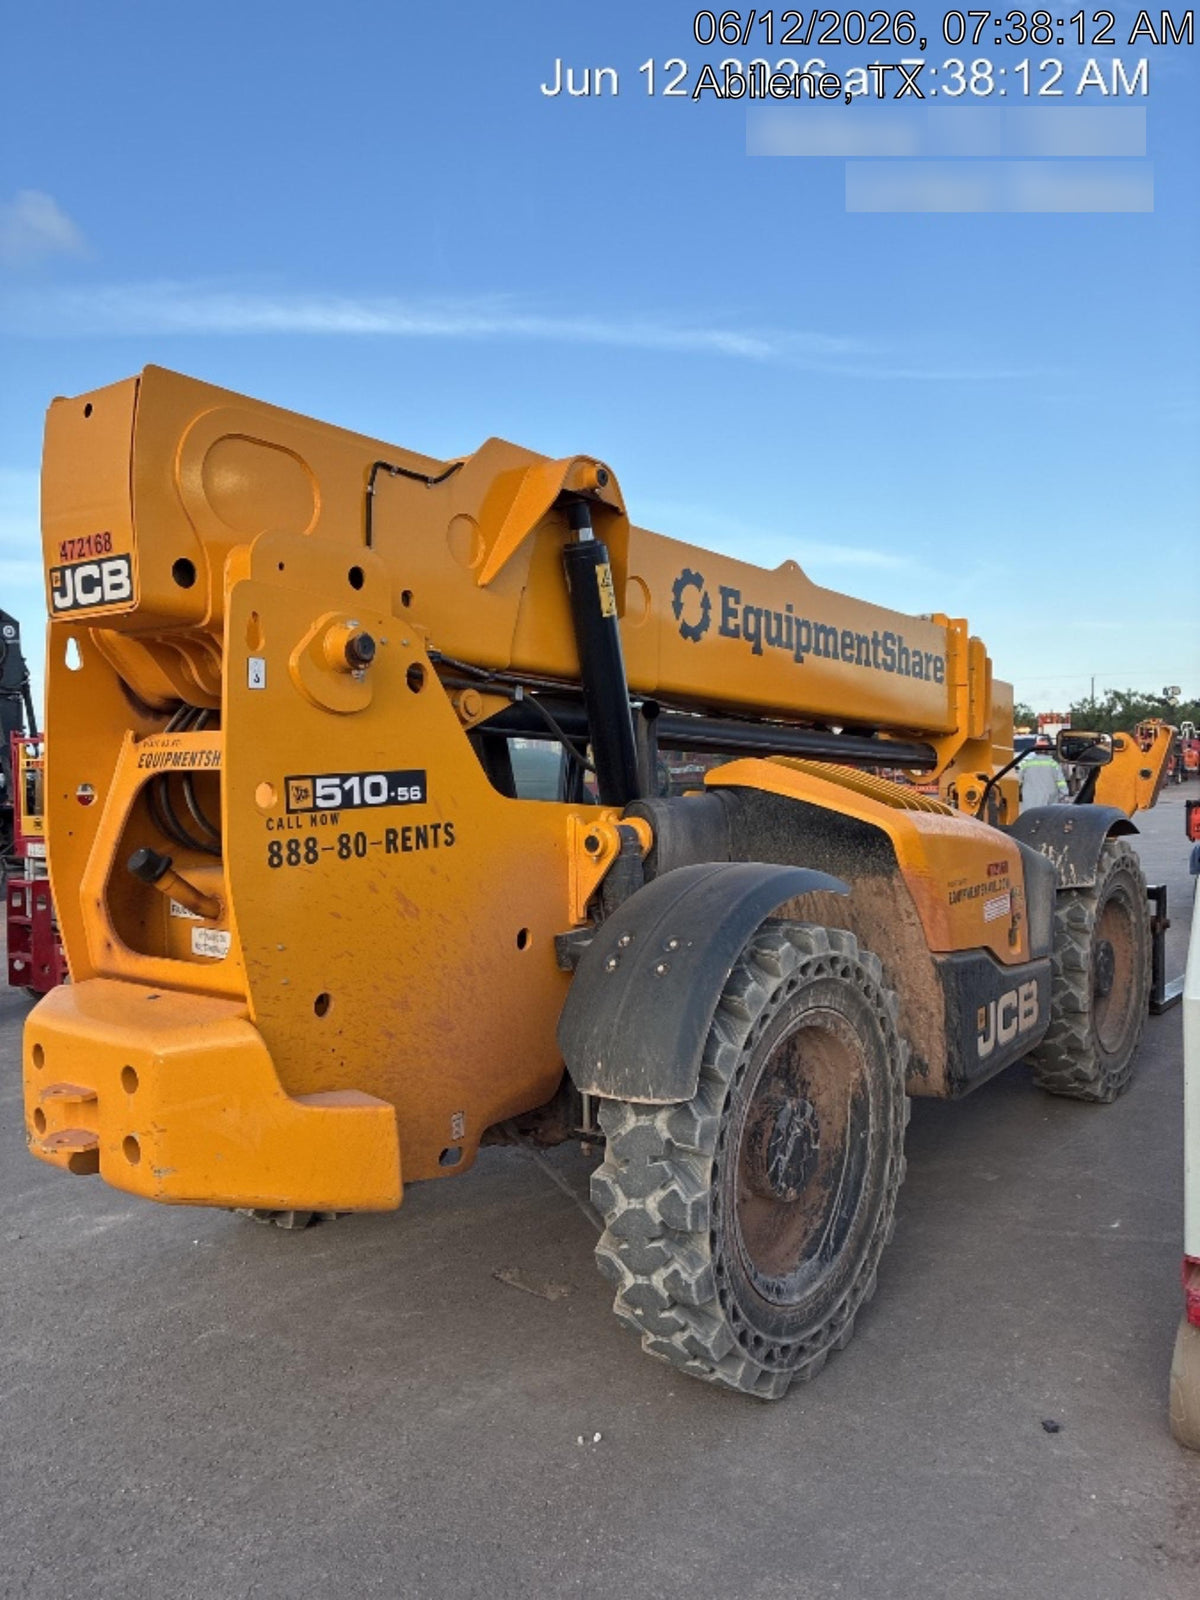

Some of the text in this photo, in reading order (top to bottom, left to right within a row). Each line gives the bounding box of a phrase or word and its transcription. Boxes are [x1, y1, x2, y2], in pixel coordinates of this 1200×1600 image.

[60, 531, 113, 560] 472168
[53, 559, 131, 609] JCB
[718, 585, 944, 684] EquipmentShare
[138, 750, 222, 768] EQUIPMENTSH
[266, 812, 341, 831] CALL NOW
[267, 822, 456, 868] 888-80-RENTS
[977, 979, 1039, 1057] JCB
